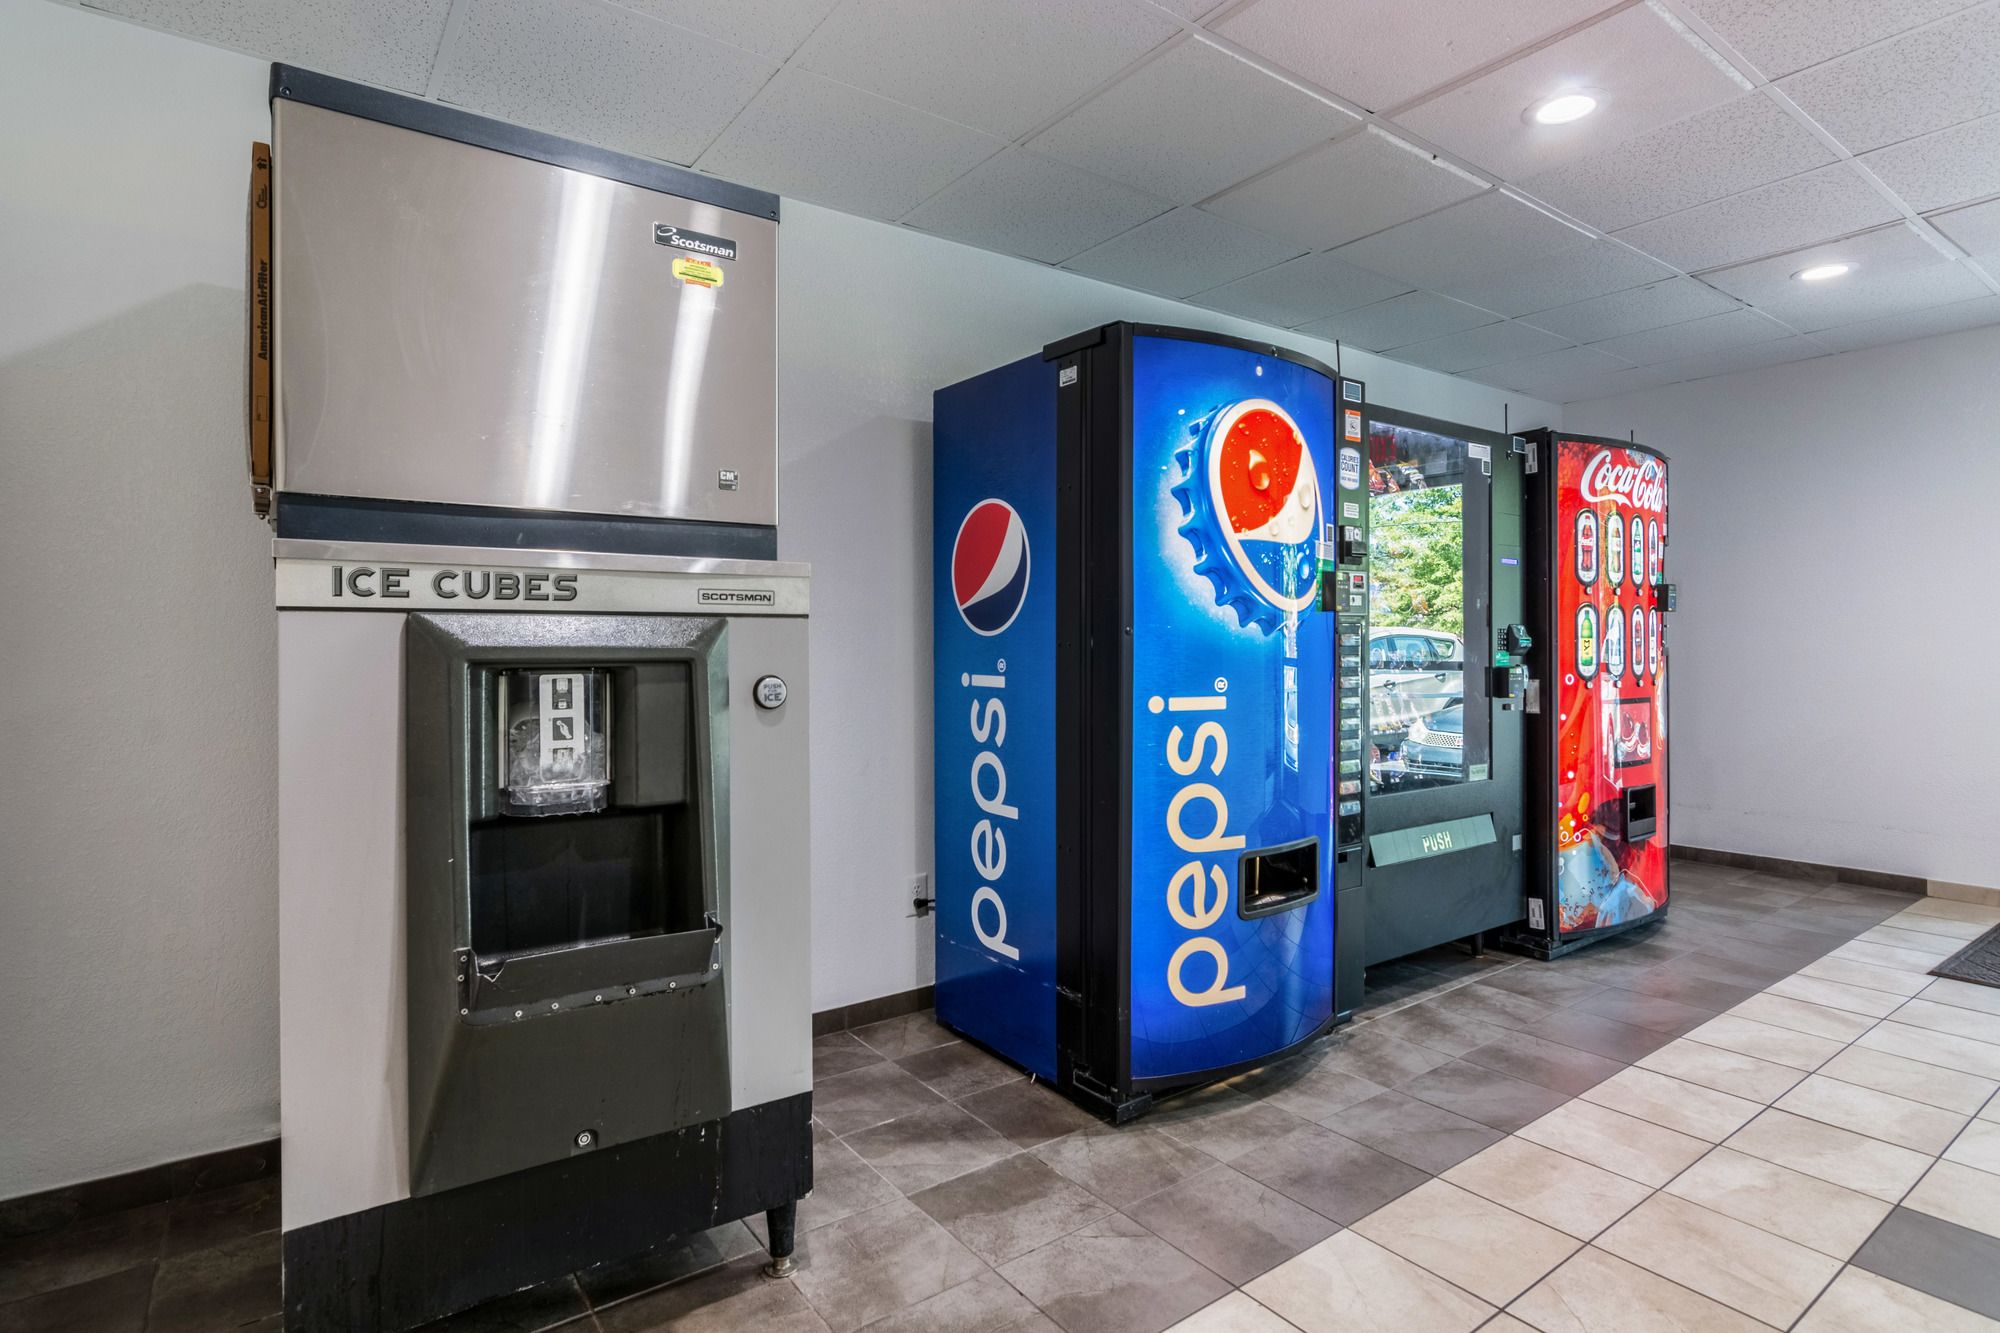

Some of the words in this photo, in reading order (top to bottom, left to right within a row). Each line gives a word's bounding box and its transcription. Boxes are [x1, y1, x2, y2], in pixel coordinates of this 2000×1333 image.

[670, 234, 734, 257] Scotsman
[1580, 450, 1664, 512] Coca-Cola
[332, 566, 410, 598] ICE
[431, 569, 577, 602] CUBES
[702, 592, 772, 602] SCOTSMAN
[764, 693, 782, 702] ICE
[1422, 831, 1453, 853] PUSH
